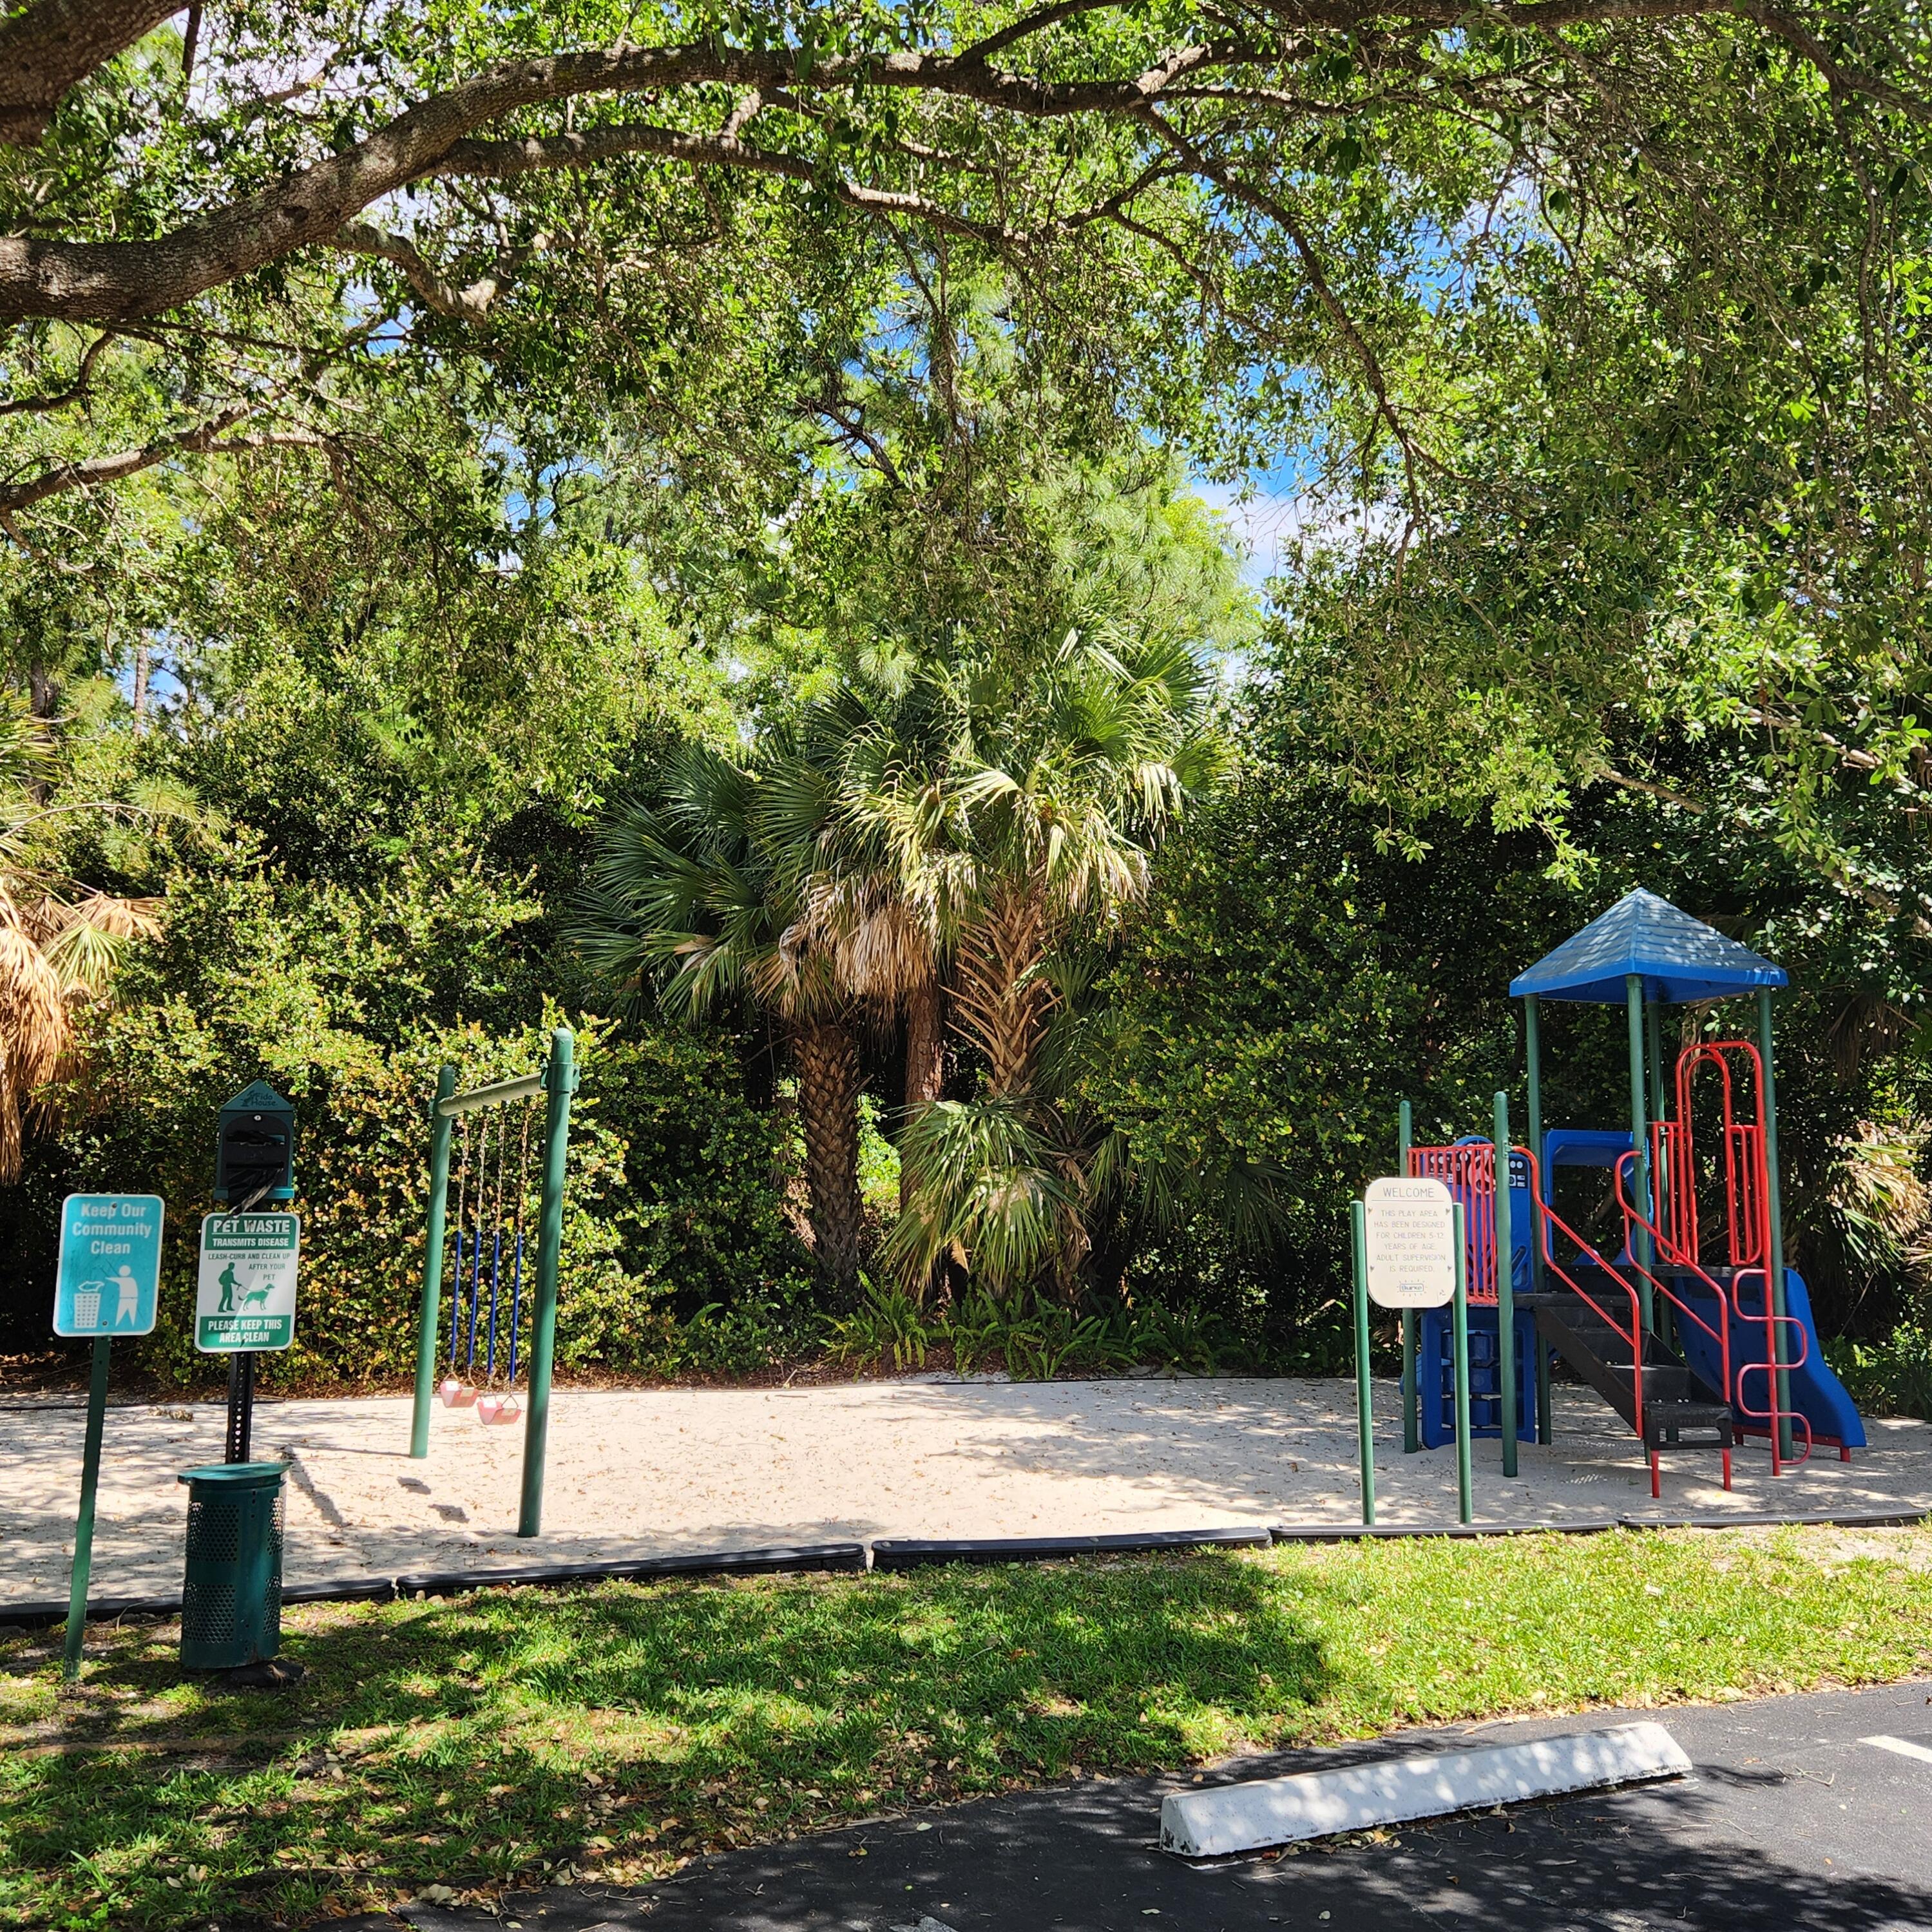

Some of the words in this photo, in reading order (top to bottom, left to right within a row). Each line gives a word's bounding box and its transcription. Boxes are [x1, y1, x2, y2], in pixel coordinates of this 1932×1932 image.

[1383, 1187, 1435, 1198] WELCOME
[81, 1201, 117, 1219] Keep
[121, 1203, 146, 1217] Our
[72, 1221, 152, 1238] Community
[213, 1219, 240, 1233] PET
[244, 1219, 290, 1233] WASTE
[91, 1240, 131, 1254] Clean
[213, 1238, 256, 1247] TRANSMITS
[258, 1238, 289, 1247] DISEASE
[208, 1320, 238, 1331] PLEASE
[241, 1319, 262, 1330] KEEP
[264, 1319, 282, 1330] THIS
[220, 1332, 241, 1343] AREA
[243, 1332, 269, 1343] CLEAN
